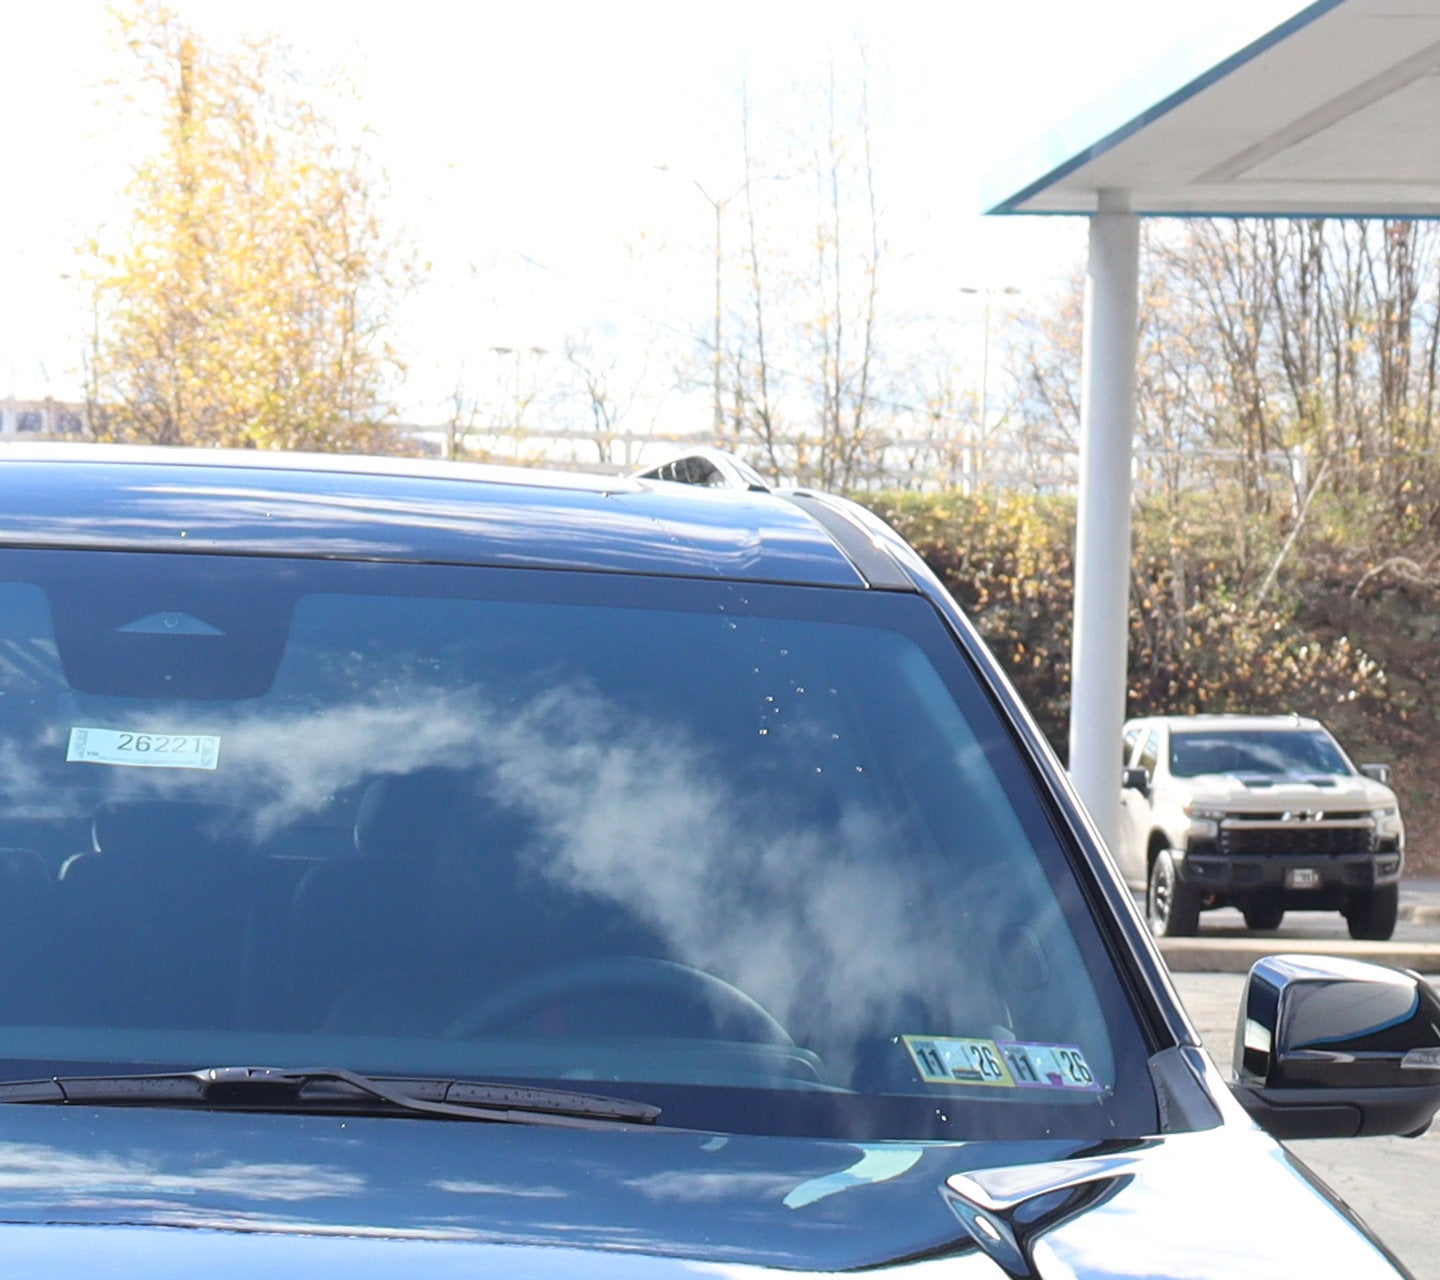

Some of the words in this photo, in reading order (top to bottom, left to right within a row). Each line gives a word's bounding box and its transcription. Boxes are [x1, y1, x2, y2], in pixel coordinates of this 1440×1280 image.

[116, 733, 202, 753] 26221
[970, 1045, 1004, 1078] 26
[1060, 1050, 1094, 1083] 26
